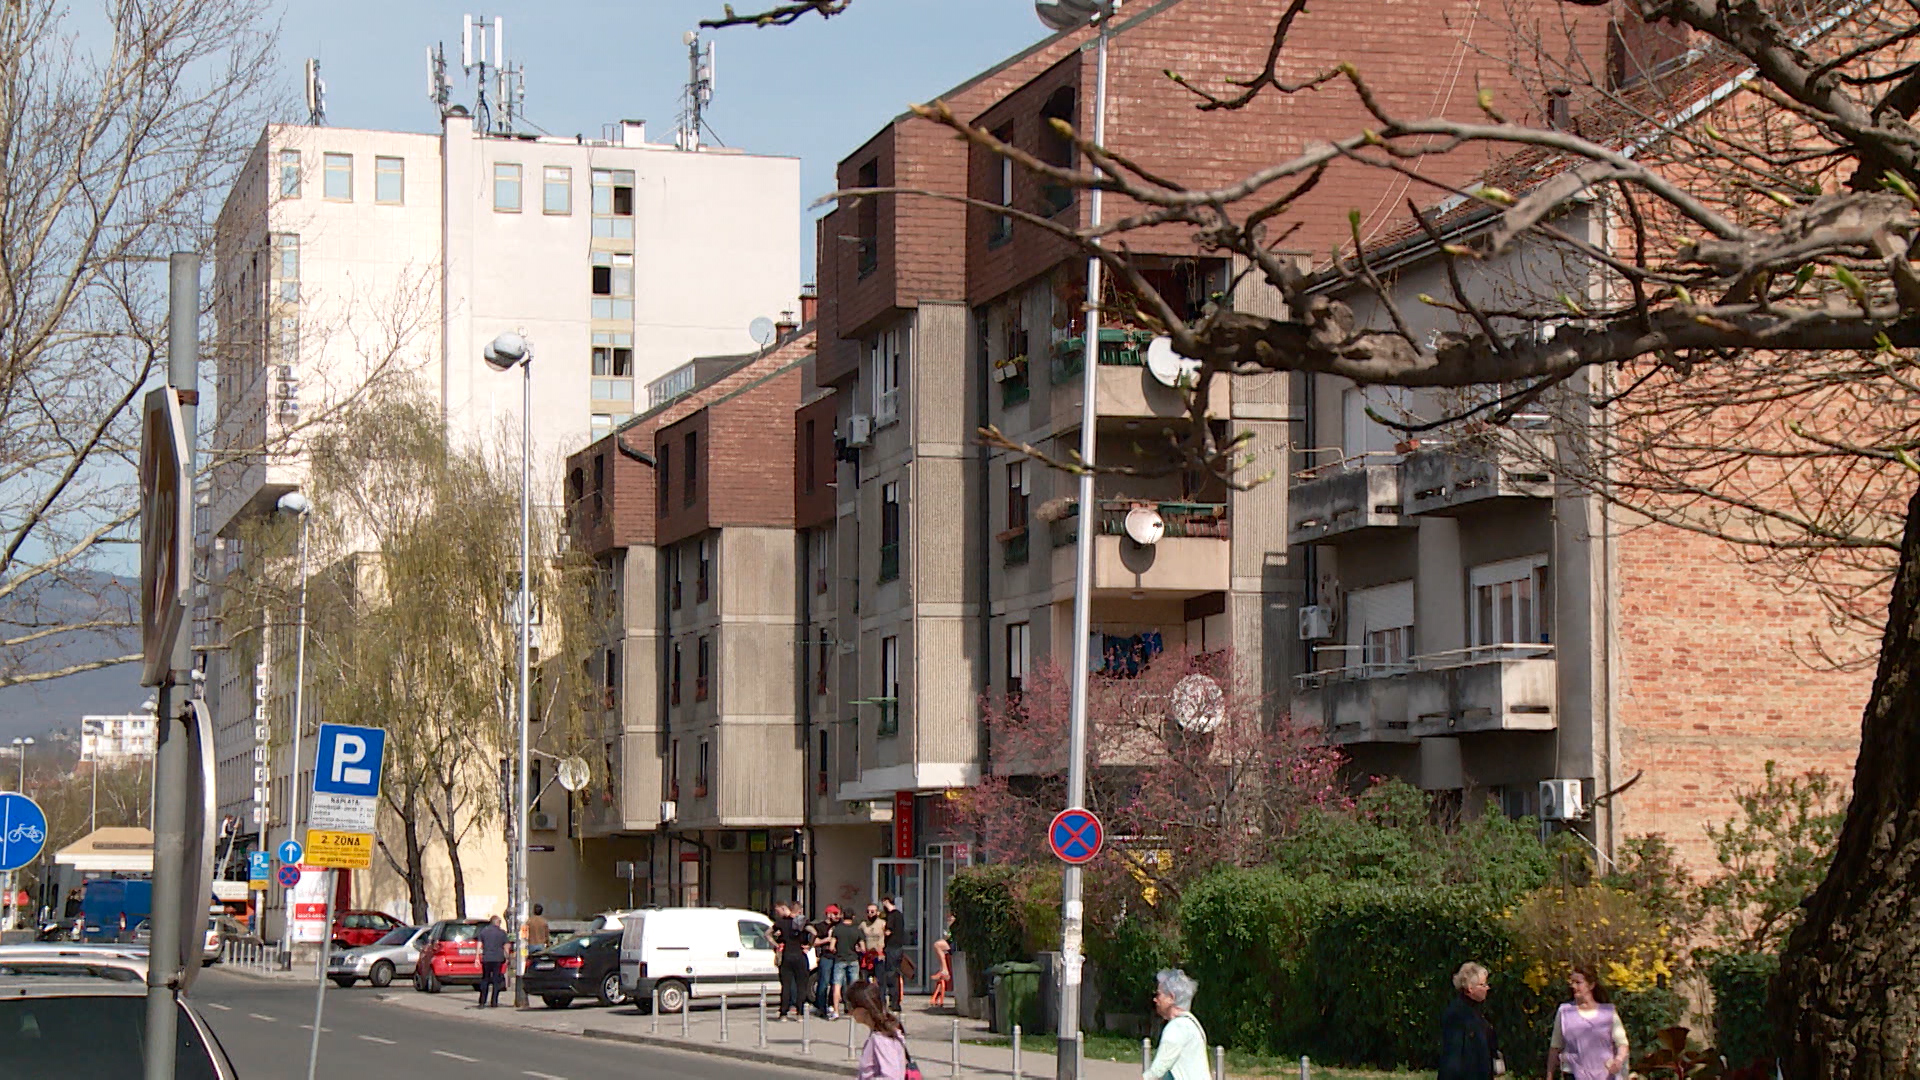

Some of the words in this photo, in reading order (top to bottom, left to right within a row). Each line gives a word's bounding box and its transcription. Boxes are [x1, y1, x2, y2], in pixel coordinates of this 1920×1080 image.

[331, 733, 366, 782] P
[321, 835, 330, 843] 2.
[333, 836, 361, 846] ZONA
